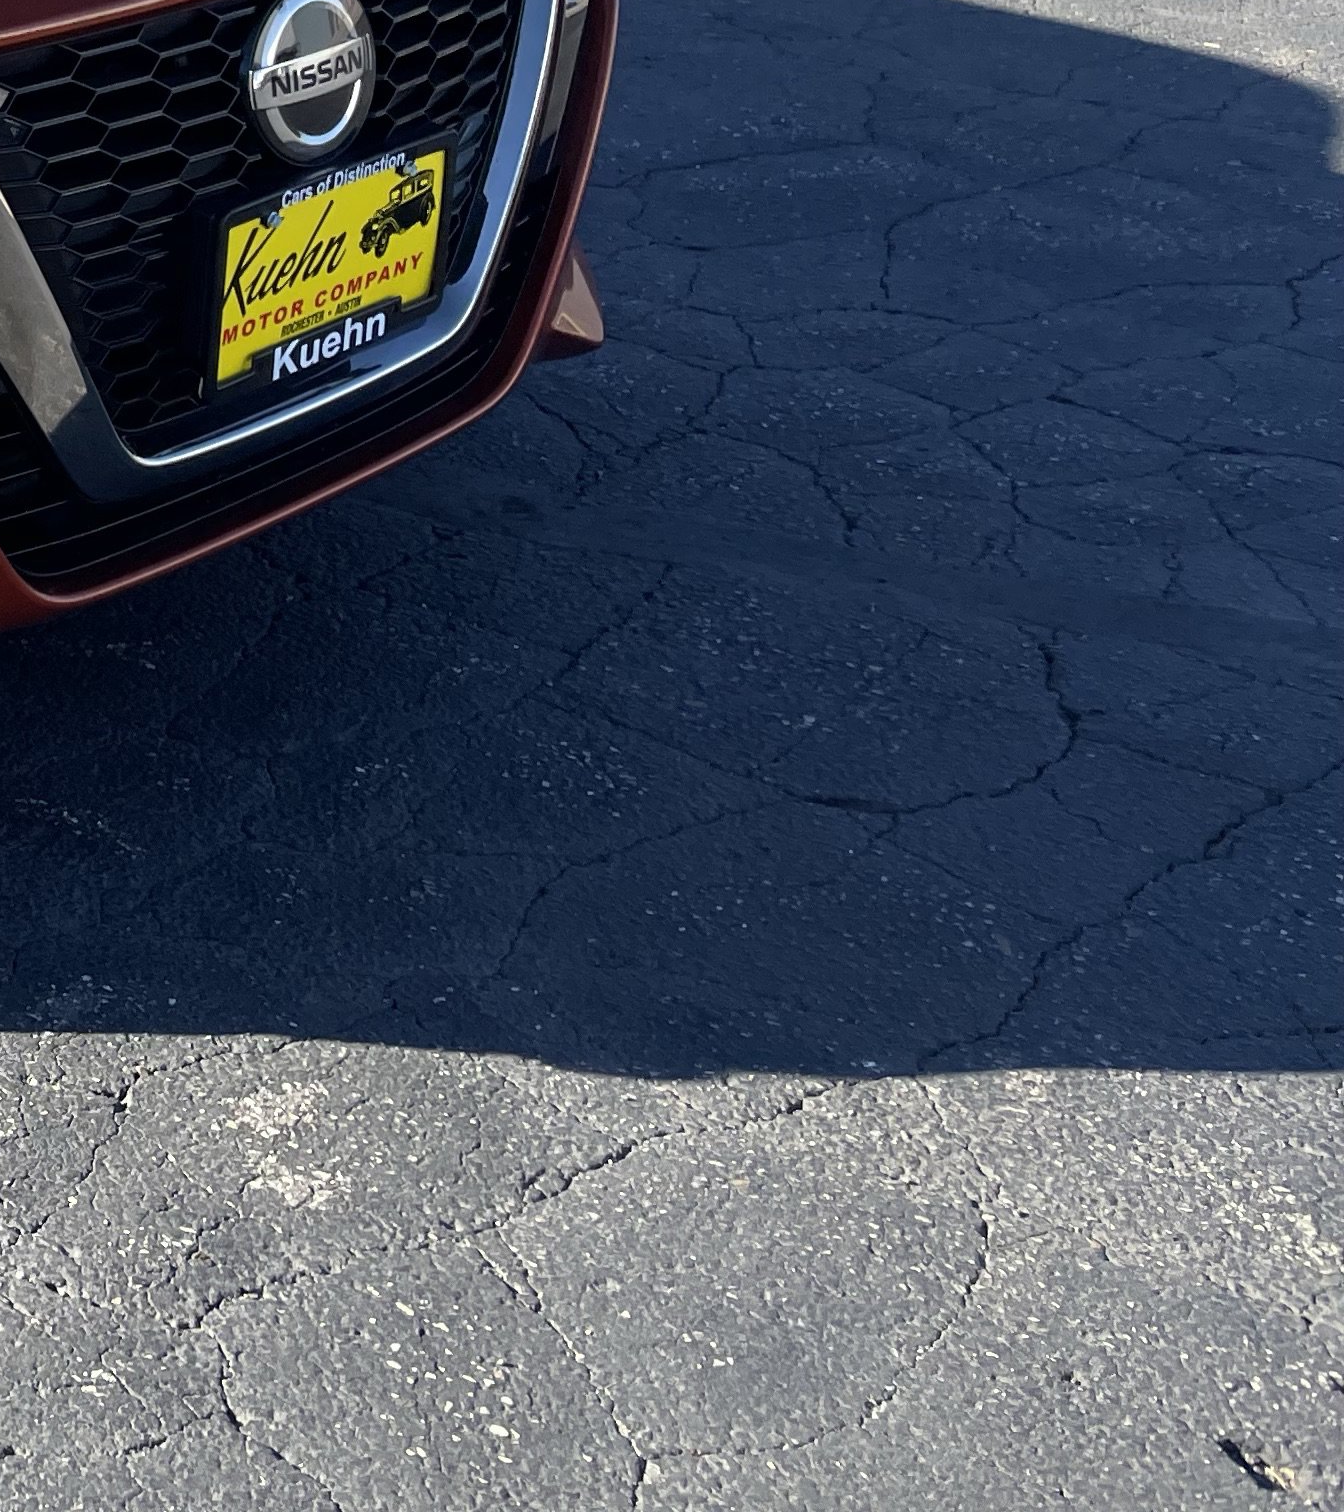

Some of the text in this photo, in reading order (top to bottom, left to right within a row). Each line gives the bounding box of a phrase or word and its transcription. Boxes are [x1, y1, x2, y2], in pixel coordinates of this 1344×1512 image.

[272, 46, 362, 97] NISSAN
[281, 152, 406, 208] Cars of Distinction
[223, 200, 347, 317] Kuehn
[222, 252, 423, 346] MOTOR COMPANY
[280, 295, 363, 338] ROCHESTER AUSTIN
[271, 311, 386, 381] Kuehn
